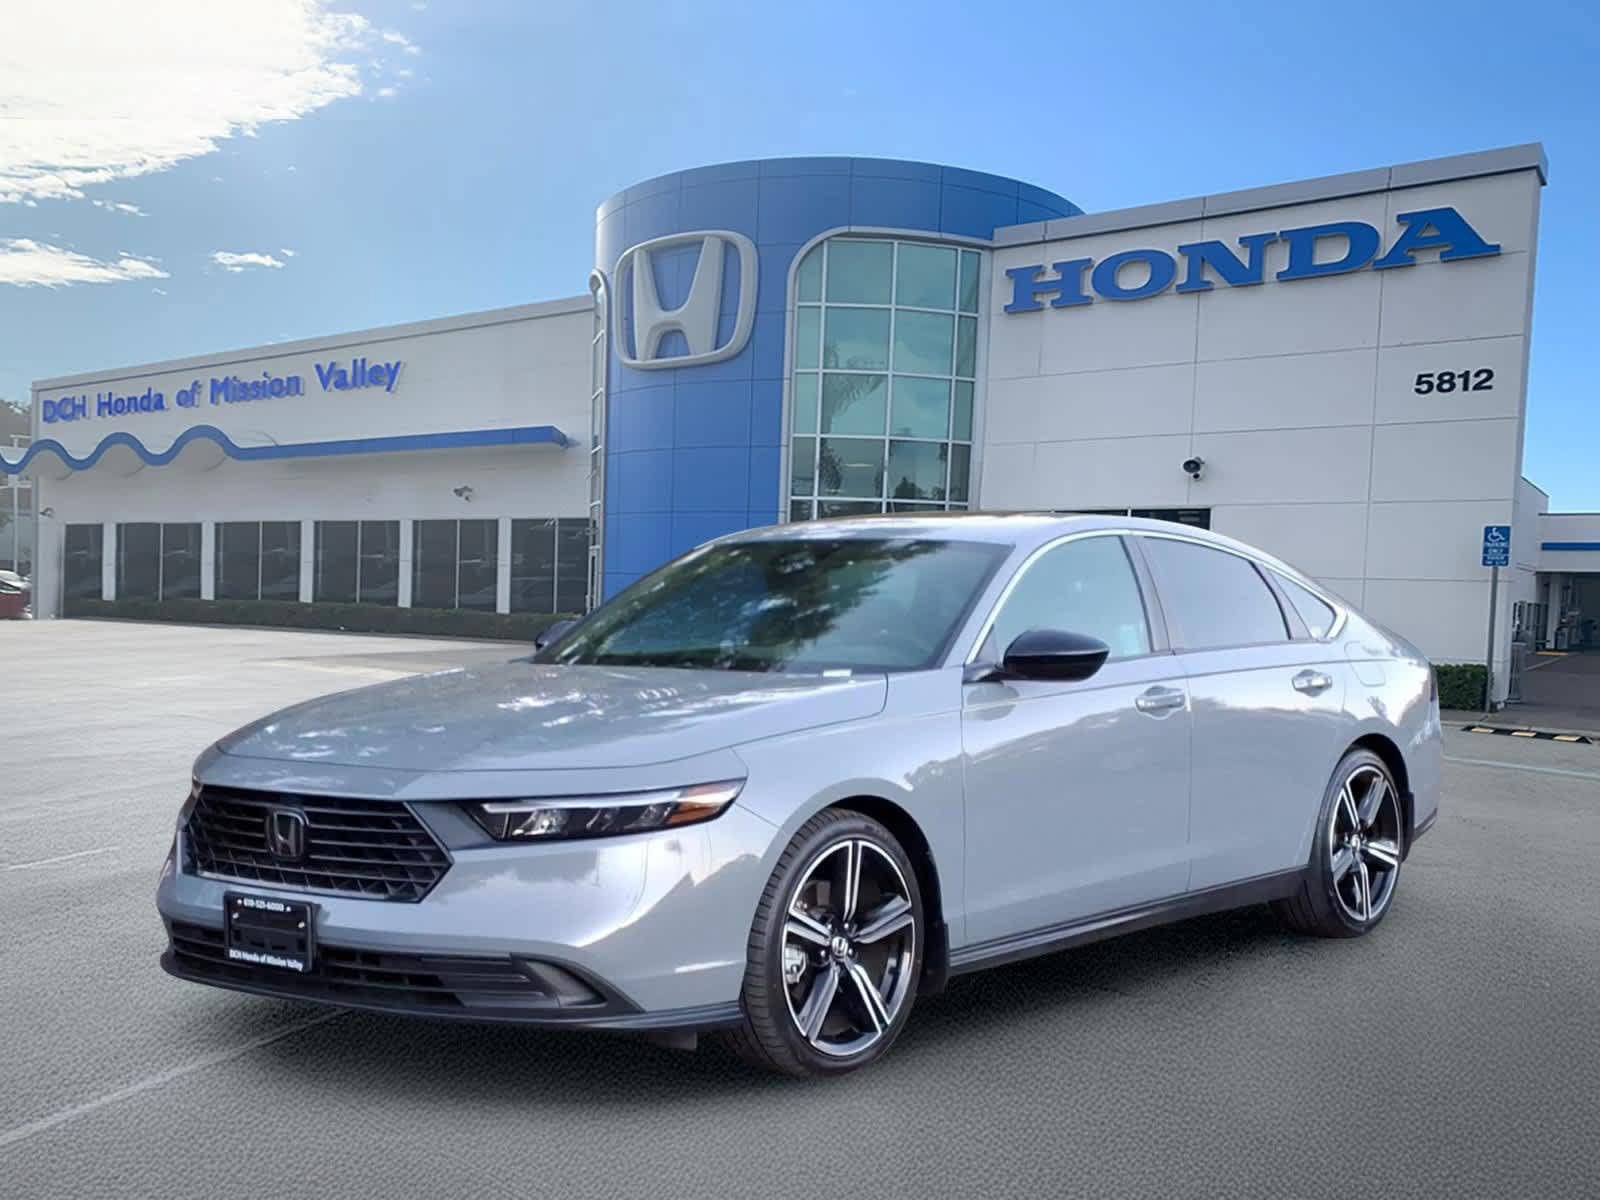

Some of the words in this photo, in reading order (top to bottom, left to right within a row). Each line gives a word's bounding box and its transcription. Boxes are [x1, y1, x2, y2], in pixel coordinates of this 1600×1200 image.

[1004, 206, 1501, 313] HONDA
[42, 394, 87, 424] DCH
[97, 386, 165, 417] Honda
[176, 380, 201, 408] of
[209, 371, 302, 405] Mission
[314, 357, 401, 393] Valley
[1414, 368, 1494, 395] 5812
